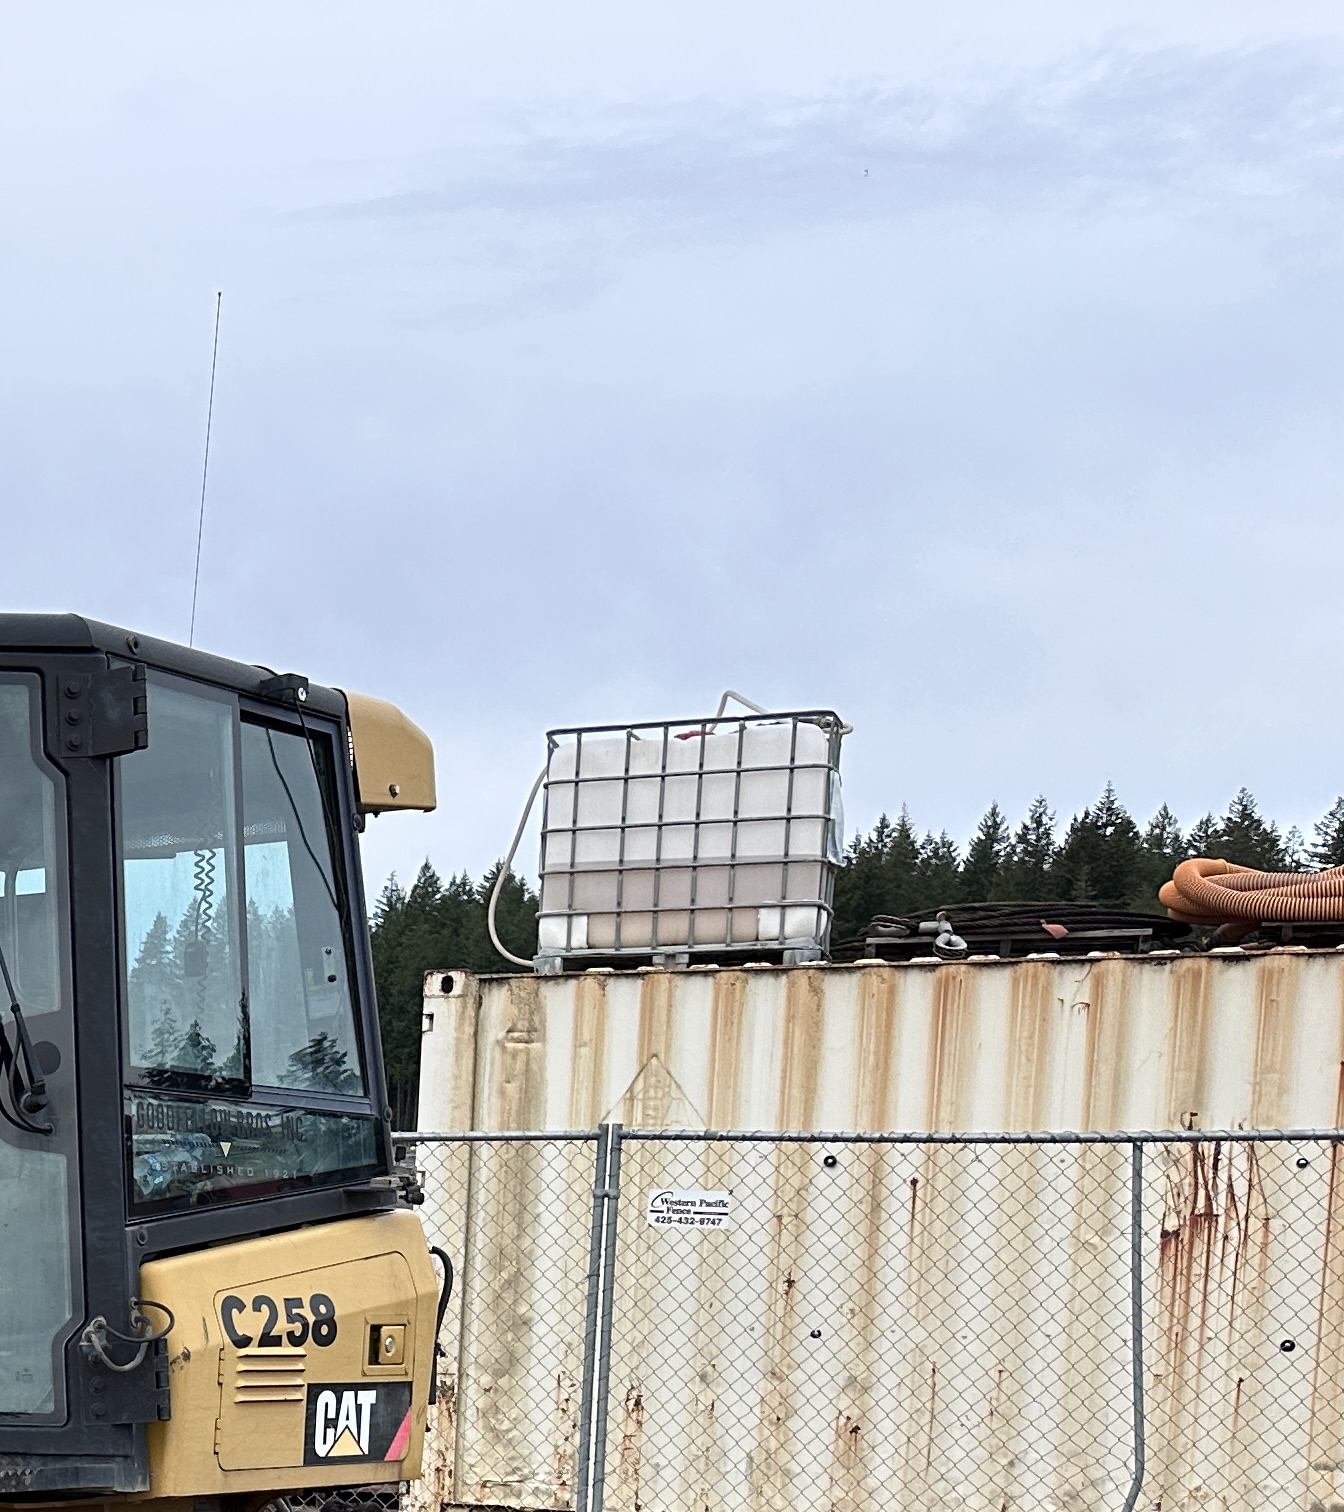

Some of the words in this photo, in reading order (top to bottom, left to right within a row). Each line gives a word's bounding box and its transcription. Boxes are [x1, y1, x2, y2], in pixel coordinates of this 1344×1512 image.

[136, 1101, 232, 1137] GOODFELLOW
[660, 1198, 697, 1207] Western
[698, 1199, 729, 1208] Pacific
[666, 1206, 692, 1215] Fence
[220, 1293, 338, 1349] C258
[314, 1389, 377, 1458] CAT
